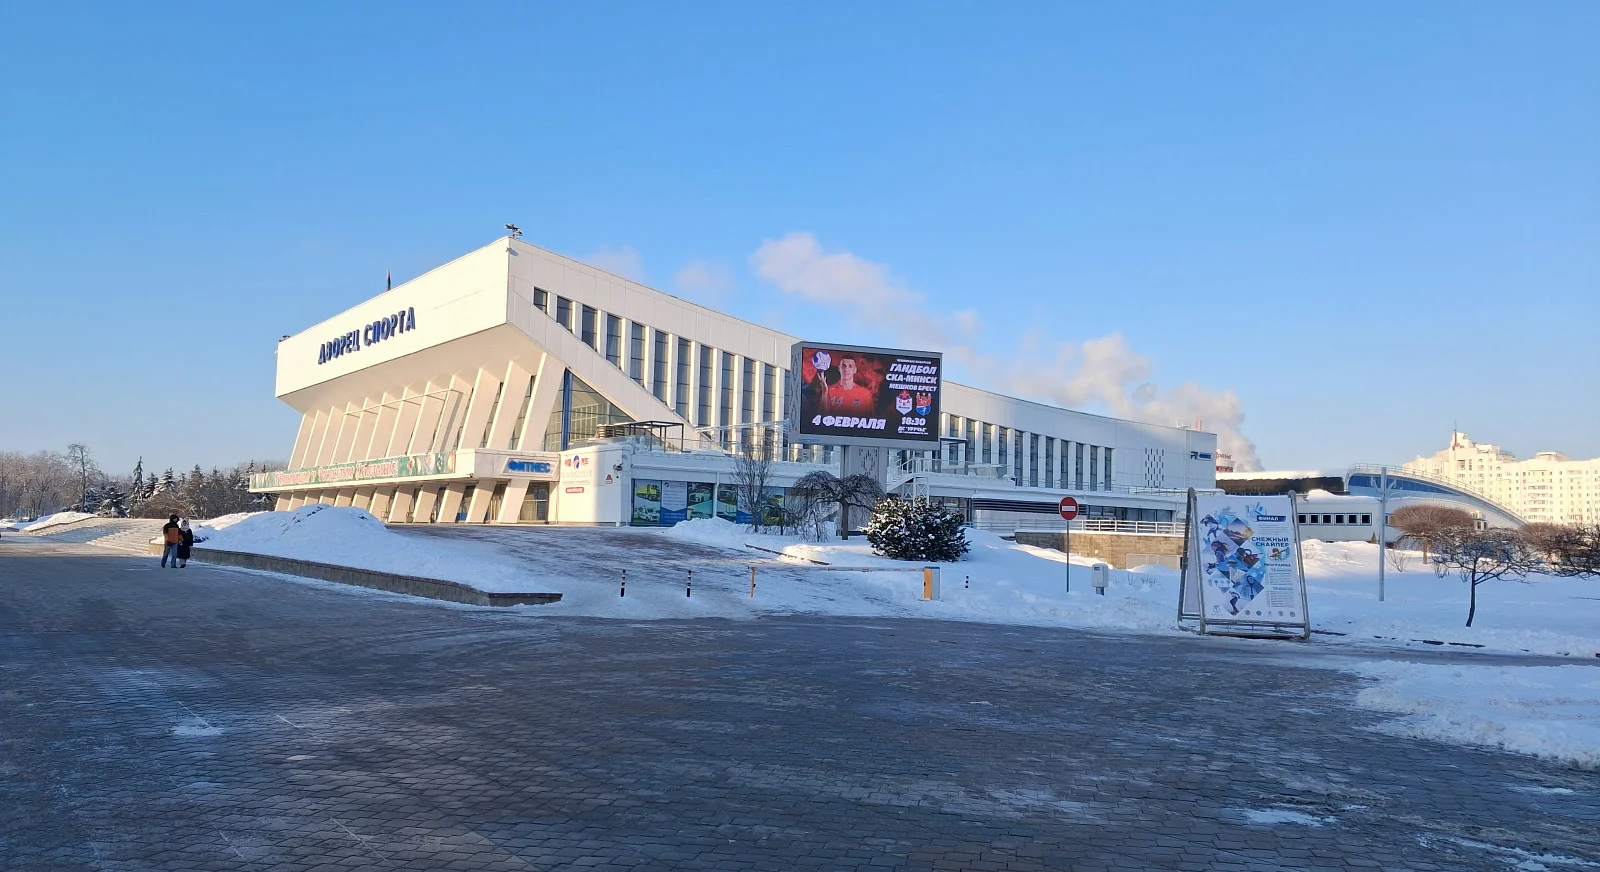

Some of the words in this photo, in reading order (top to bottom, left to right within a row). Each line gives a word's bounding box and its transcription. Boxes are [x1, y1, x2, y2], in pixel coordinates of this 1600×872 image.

[318, 329, 361, 365] ДВОРЕЦ
[363, 307, 416, 347] СПОРТА
[890, 363, 937, 374] ГАНДБОЛ
[886, 373, 937, 384] СКА-МИНСК
[889, 383, 918, 391] МЕШКОВ
[812, 414, 822, 426] 4
[822, 415, 887, 430] ФЕВРАЛЯ
[901, 417, 926, 426] 18:30
[508, 460, 551, 473] ФИТНЕС
